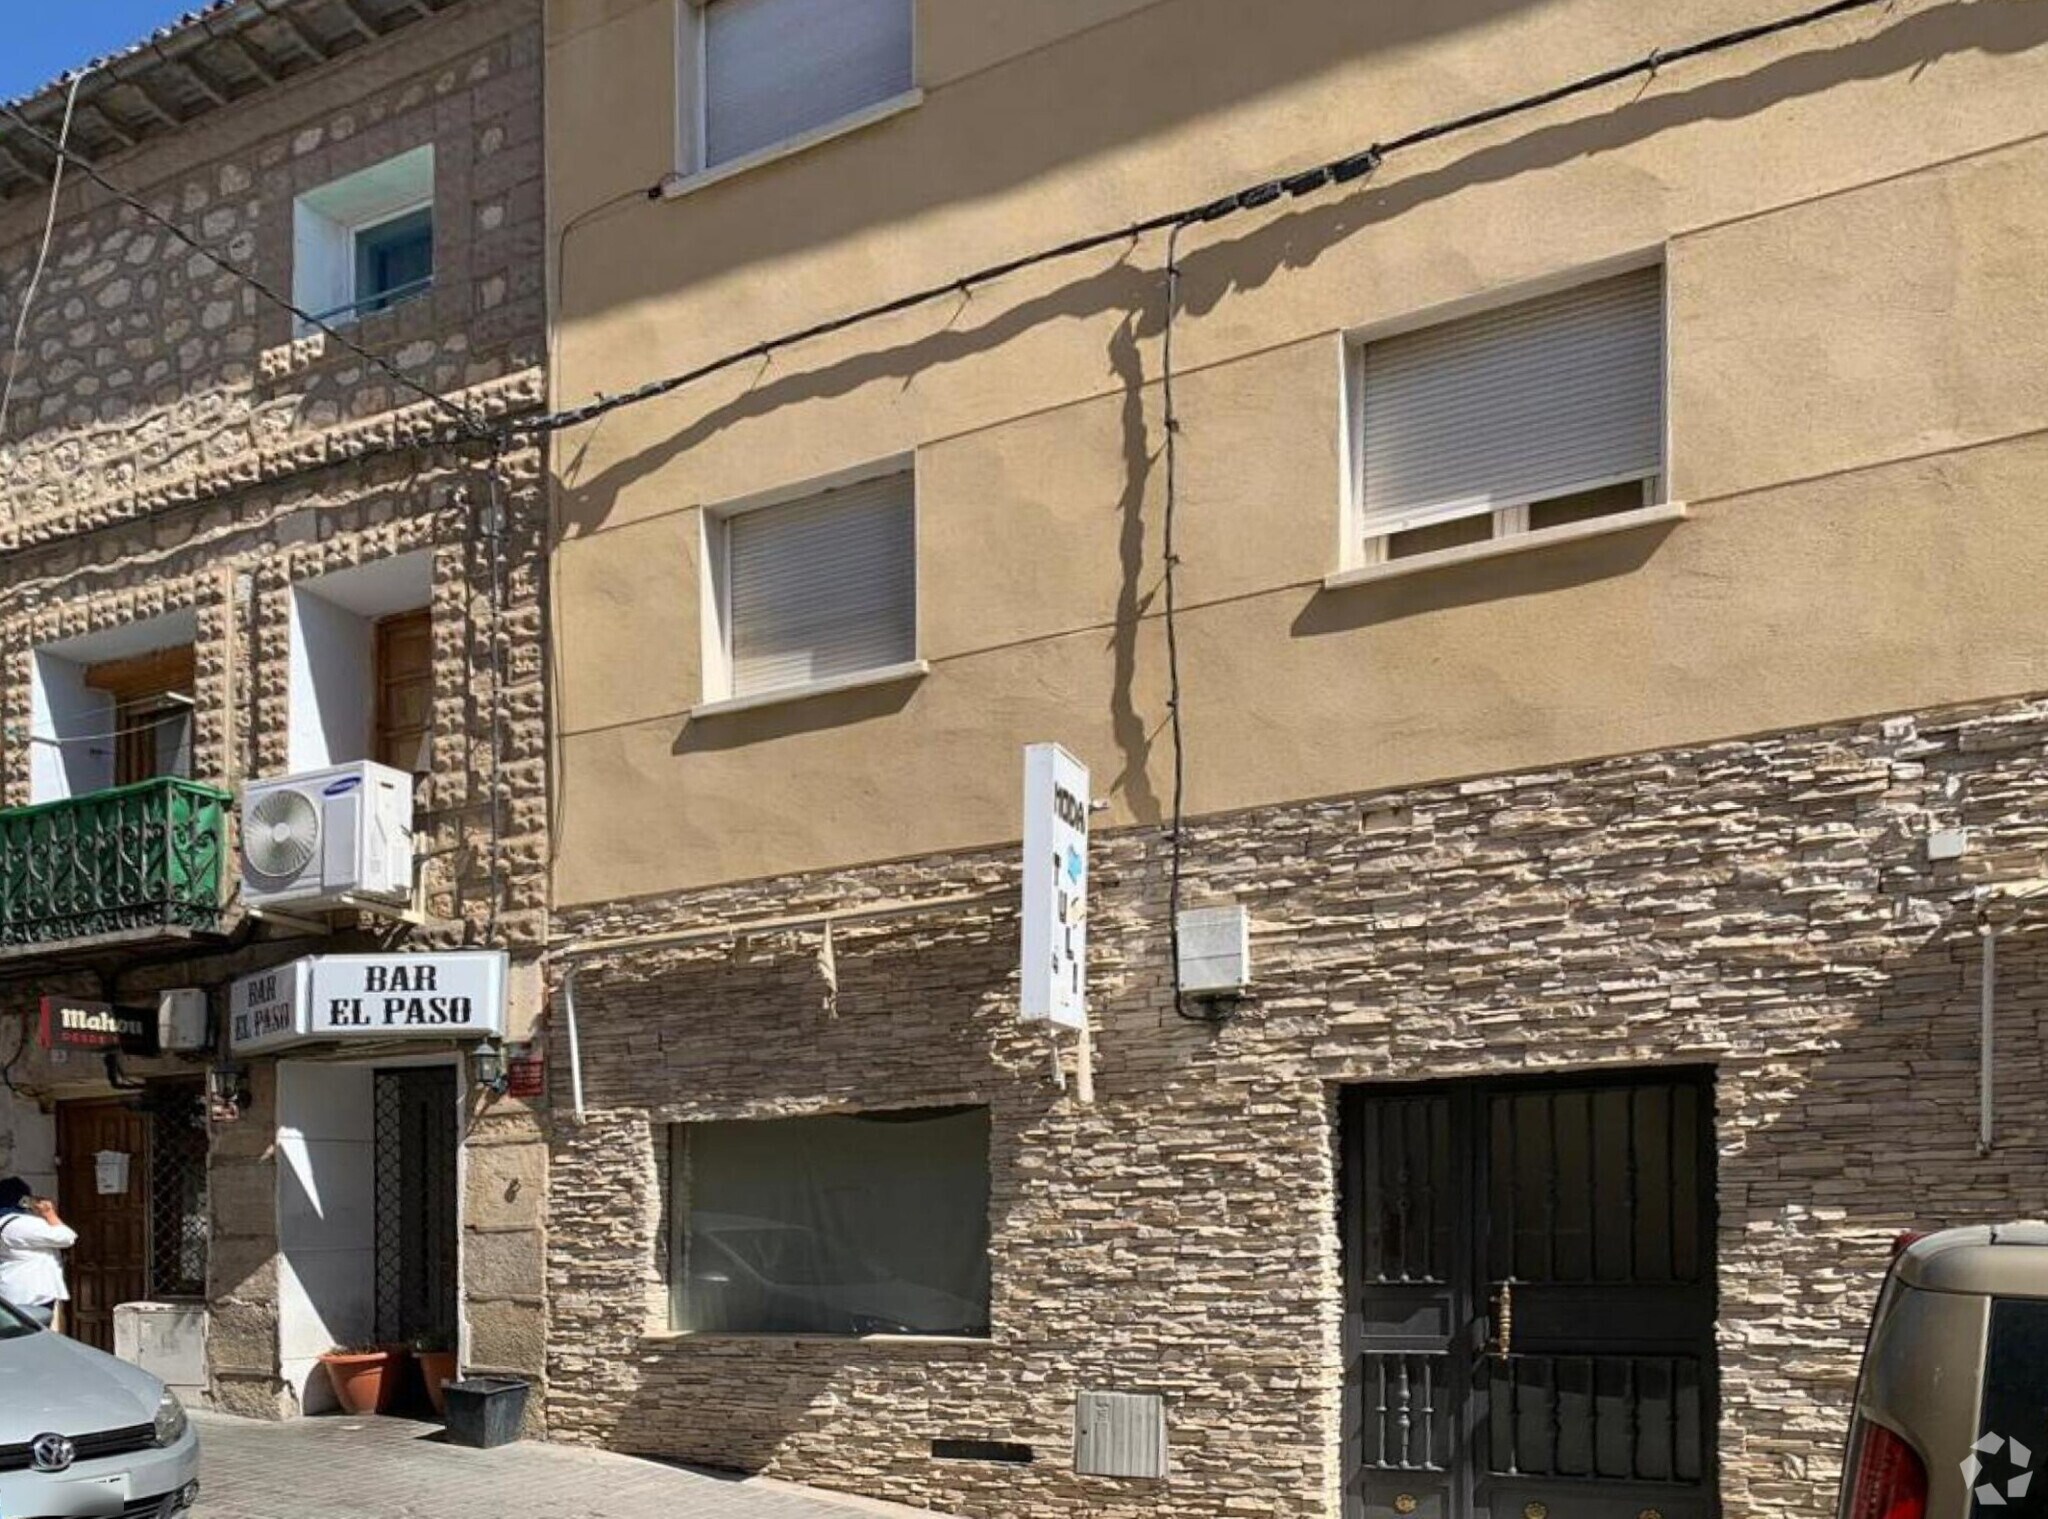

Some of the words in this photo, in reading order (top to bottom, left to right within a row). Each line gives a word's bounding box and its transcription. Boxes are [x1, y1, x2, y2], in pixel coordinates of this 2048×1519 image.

[247, 975, 277, 1007] BAR
[364, 964, 436, 992] BAR
[60, 1007, 144, 1036] Mahou
[234, 1013, 252, 1041] EL
[254, 1002, 291, 1037] PASO
[329, 998, 370, 1026] EL
[382, 997, 471, 1025] PASO
